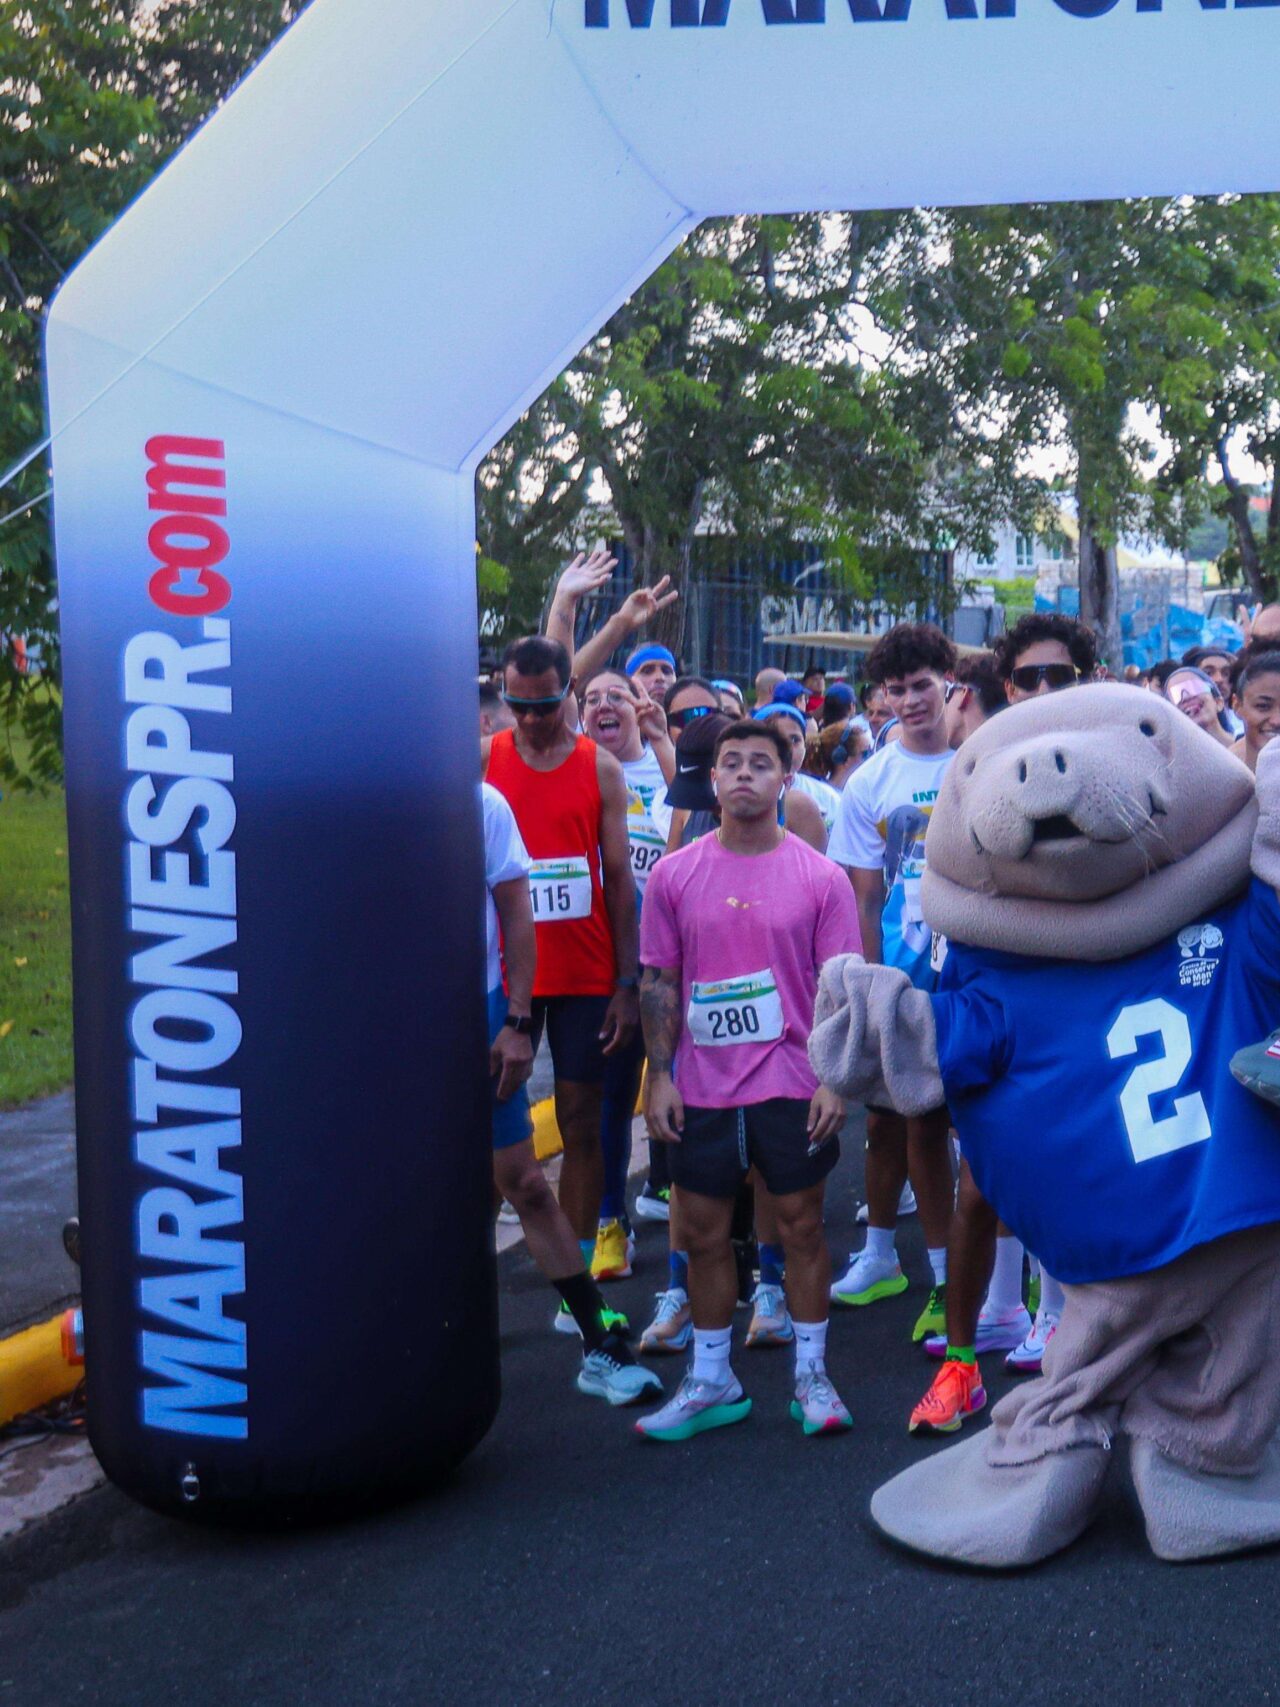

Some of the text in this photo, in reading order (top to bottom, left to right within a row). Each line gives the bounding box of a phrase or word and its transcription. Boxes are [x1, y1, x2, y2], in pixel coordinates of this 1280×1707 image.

[122, 434, 249, 1441] MARATONESPR.com
[707, 1005, 760, 1039] 280
[1106, 997, 1212, 1163] 2
